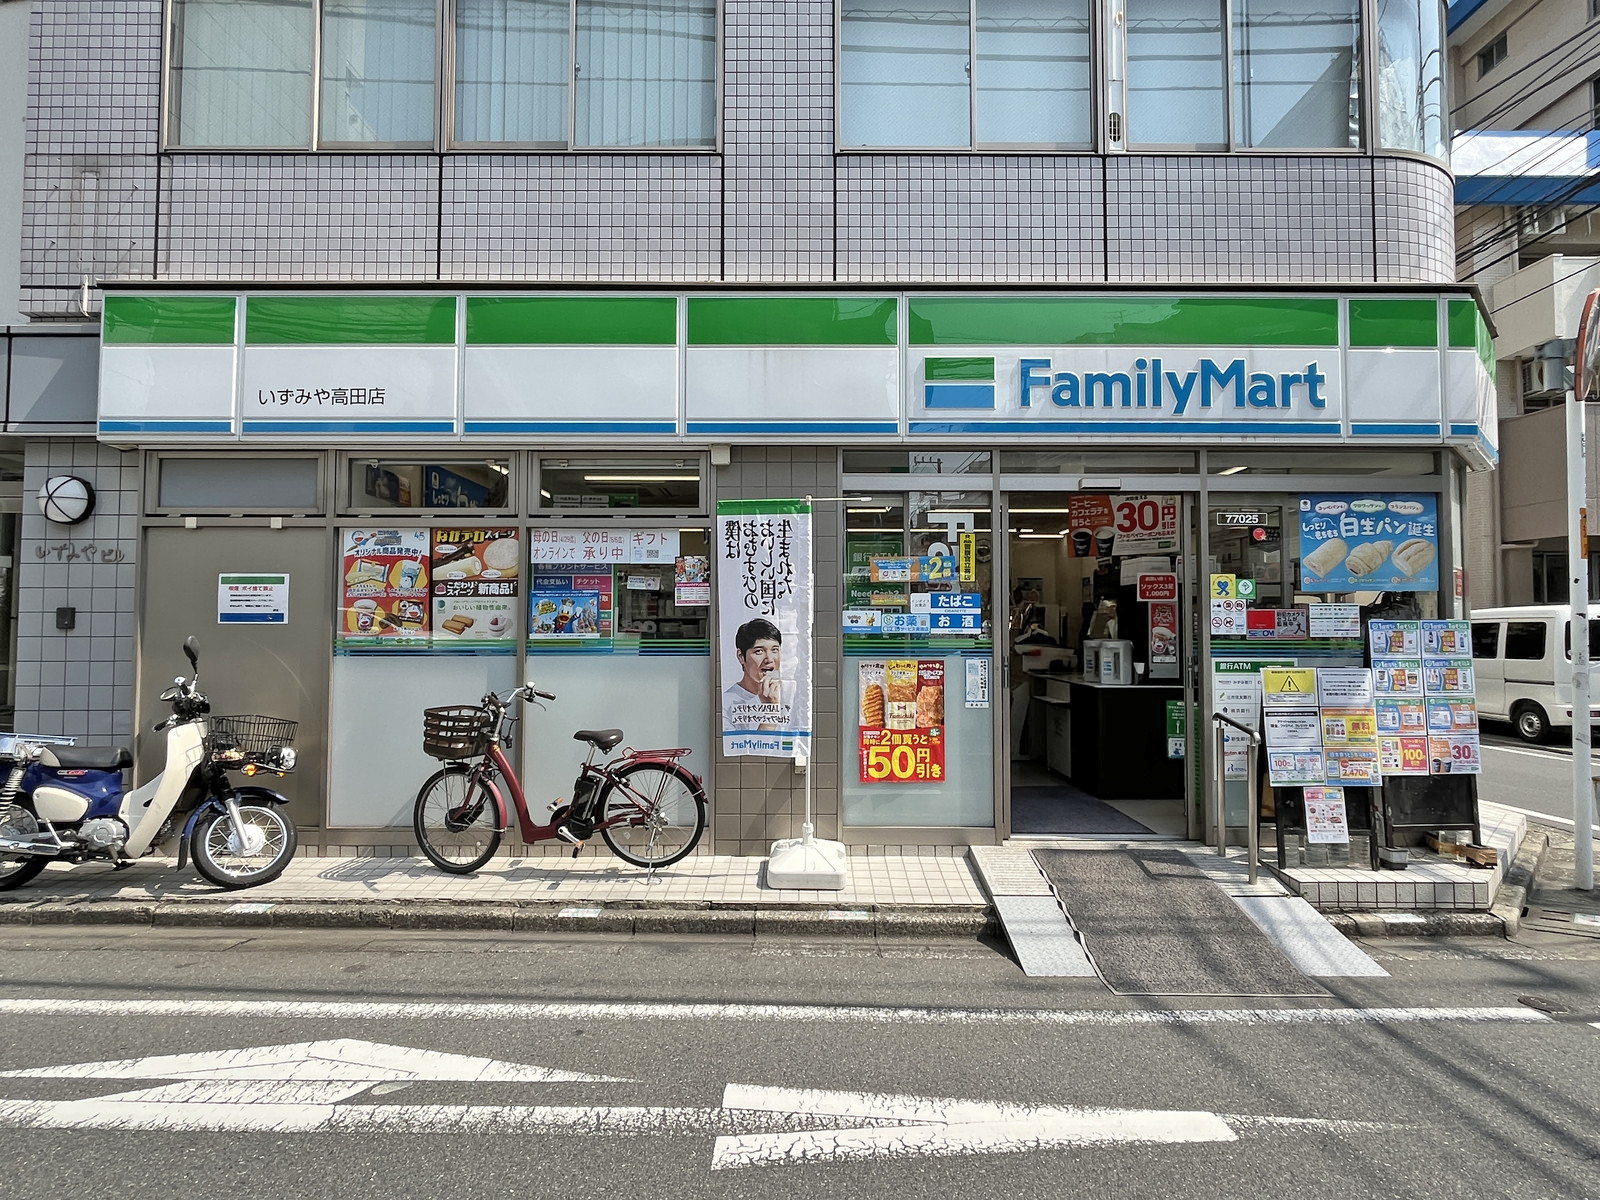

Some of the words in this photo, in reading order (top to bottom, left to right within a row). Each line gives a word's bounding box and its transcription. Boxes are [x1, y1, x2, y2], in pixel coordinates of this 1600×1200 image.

[1019, 357, 1327, 416] FamilyMart
[258, 387, 386, 406] いずみや高田店
[1116, 500, 1159, 533] 30
[1162, 506, 1176, 521] 円
[1225, 514, 1259, 524] 77025
[632, 531, 669, 545] ギフト
[35, 542, 125, 563] いずみやビル
[533, 546, 576, 560] オンラインで
[582, 546, 624, 561] 承り中
[447, 581, 474, 589] こだわり
[478, 582, 514, 595] 新商品!
[851, 590, 871, 598] Need
[938, 594, 973, 607] たばこ
[1219, 662, 1251, 670] 銀行ATM
[916, 748, 930, 763] 円
[1452, 744, 1472, 760] 30
[867, 745, 916, 779] 50
[916, 763, 942, 778] 引き
